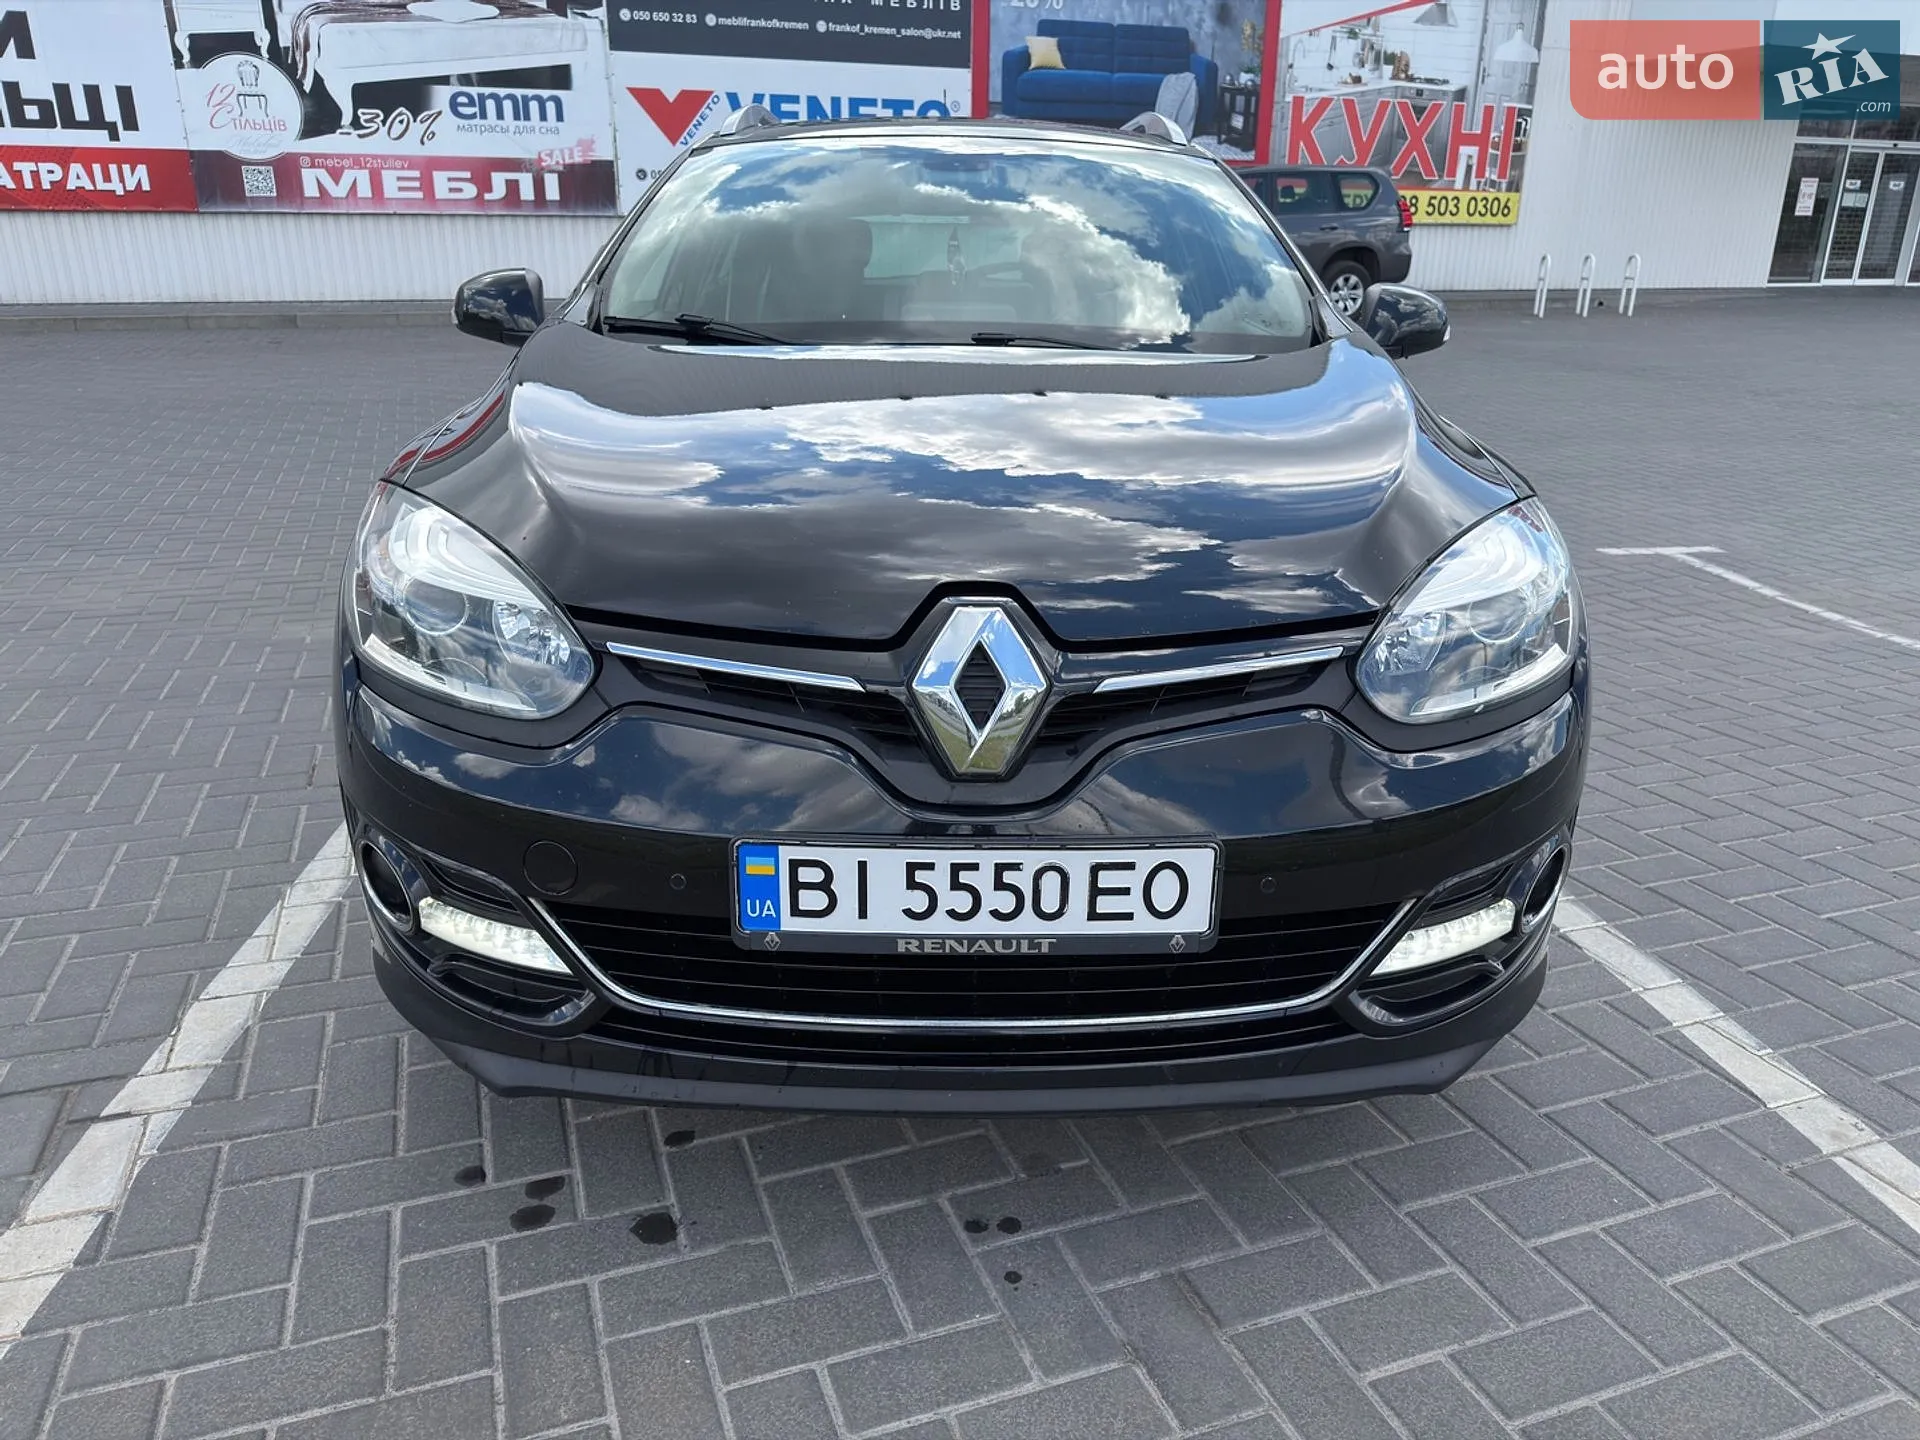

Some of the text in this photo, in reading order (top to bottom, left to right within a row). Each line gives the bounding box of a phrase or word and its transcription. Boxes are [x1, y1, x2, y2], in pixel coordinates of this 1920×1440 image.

[633, 11, 698, 23] 050 650 32 83
[206, 83, 236, 108] 12
[448, 90, 565, 123] emm
[0, 80, 140, 142] ЬЦІ
[680, 94, 721, 146] VENETO
[456, 123, 560, 136] матрасы для сна
[1286, 95, 1518, 181] КУХНІ
[540, 146, 585, 167] SALE
[301, 168, 560, 201] МЕБЛІ
[1400, 194, 1511, 218] 8 503 0306
[901, 861, 1070, 921] 5550
[1086, 861, 1190, 921] EO
[746, 898, 776, 918] UA
[897, 937, 1057, 954] RENAULT
